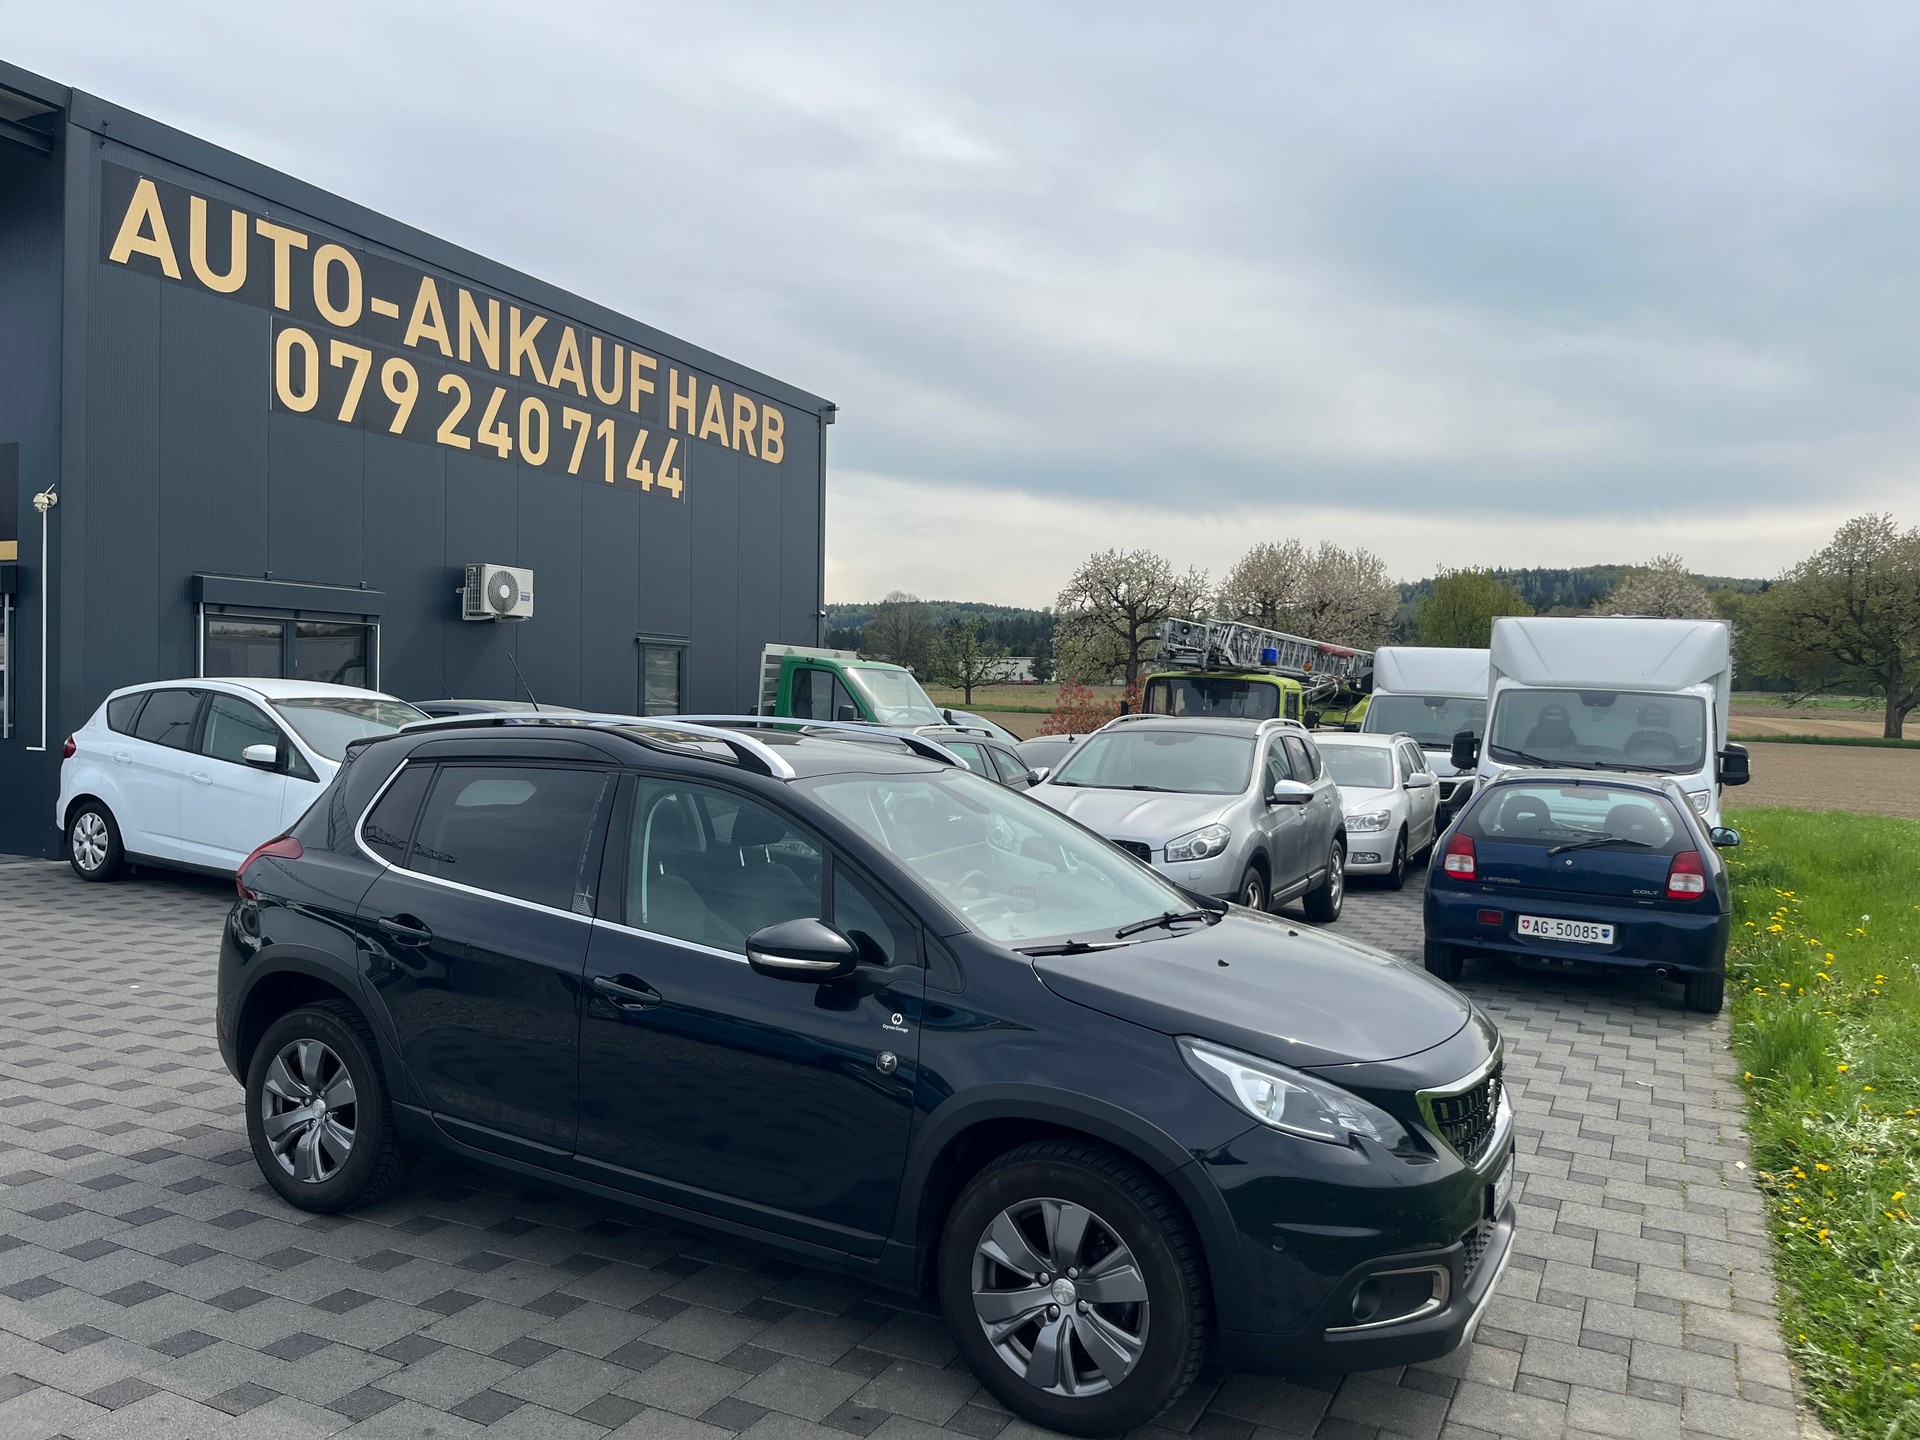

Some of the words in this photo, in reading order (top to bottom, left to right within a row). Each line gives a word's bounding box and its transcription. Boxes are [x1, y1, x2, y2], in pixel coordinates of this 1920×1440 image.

[109, 178, 657, 413] AUTO-ANKAUF
[668, 367, 785, 464] HARB
[276, 327, 419, 435] 079
[437, 373, 549, 466] 240
